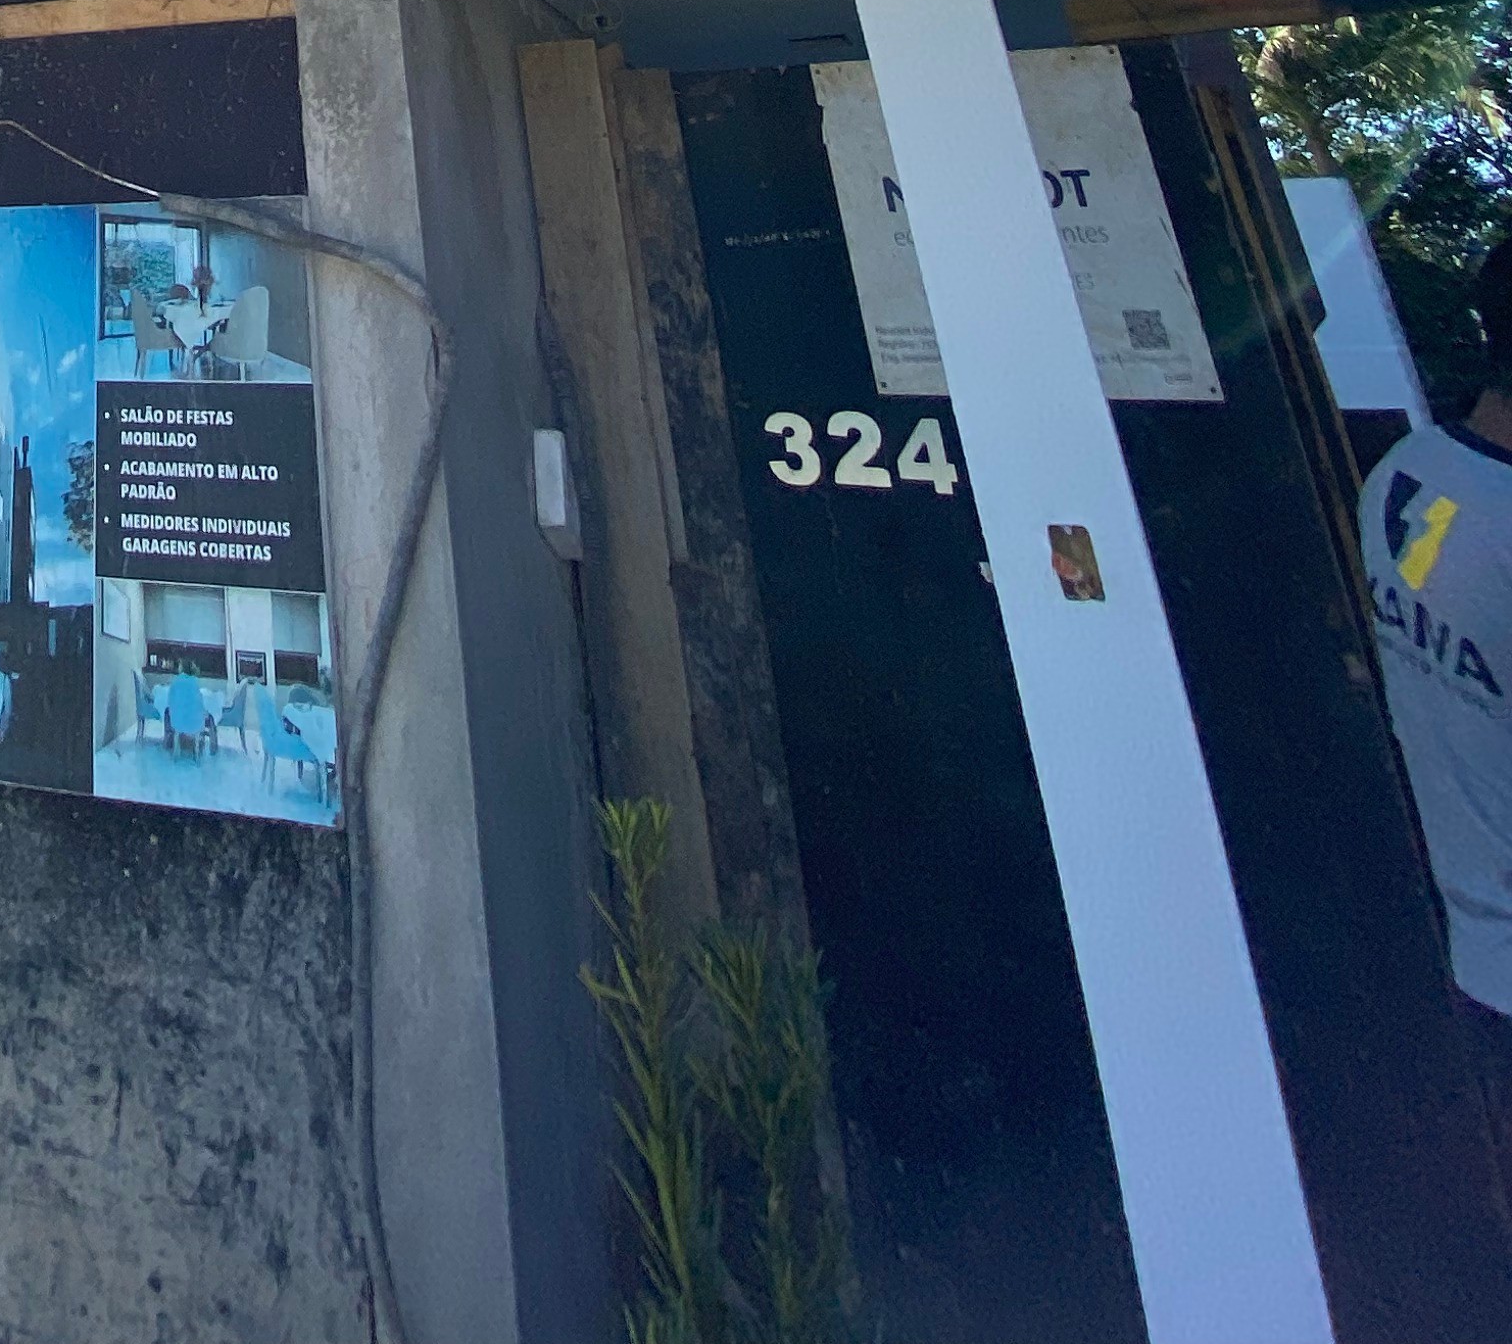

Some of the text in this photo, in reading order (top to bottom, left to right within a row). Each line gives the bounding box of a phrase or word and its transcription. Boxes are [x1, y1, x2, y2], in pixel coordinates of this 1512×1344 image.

[120, 406, 234, 425] SALÃO DE FESTAS
[121, 431, 197, 447] MOBILIADO
[764, 410, 958, 495] 324
[120, 461, 279, 481] ACABAMENTO EM ALTO
[121, 482, 177, 500] PADRÃO
[121, 513, 291, 537] MEDIDORES INDIVIDUAIS
[122, 537, 272, 561] GARAGENS COBERTAS
